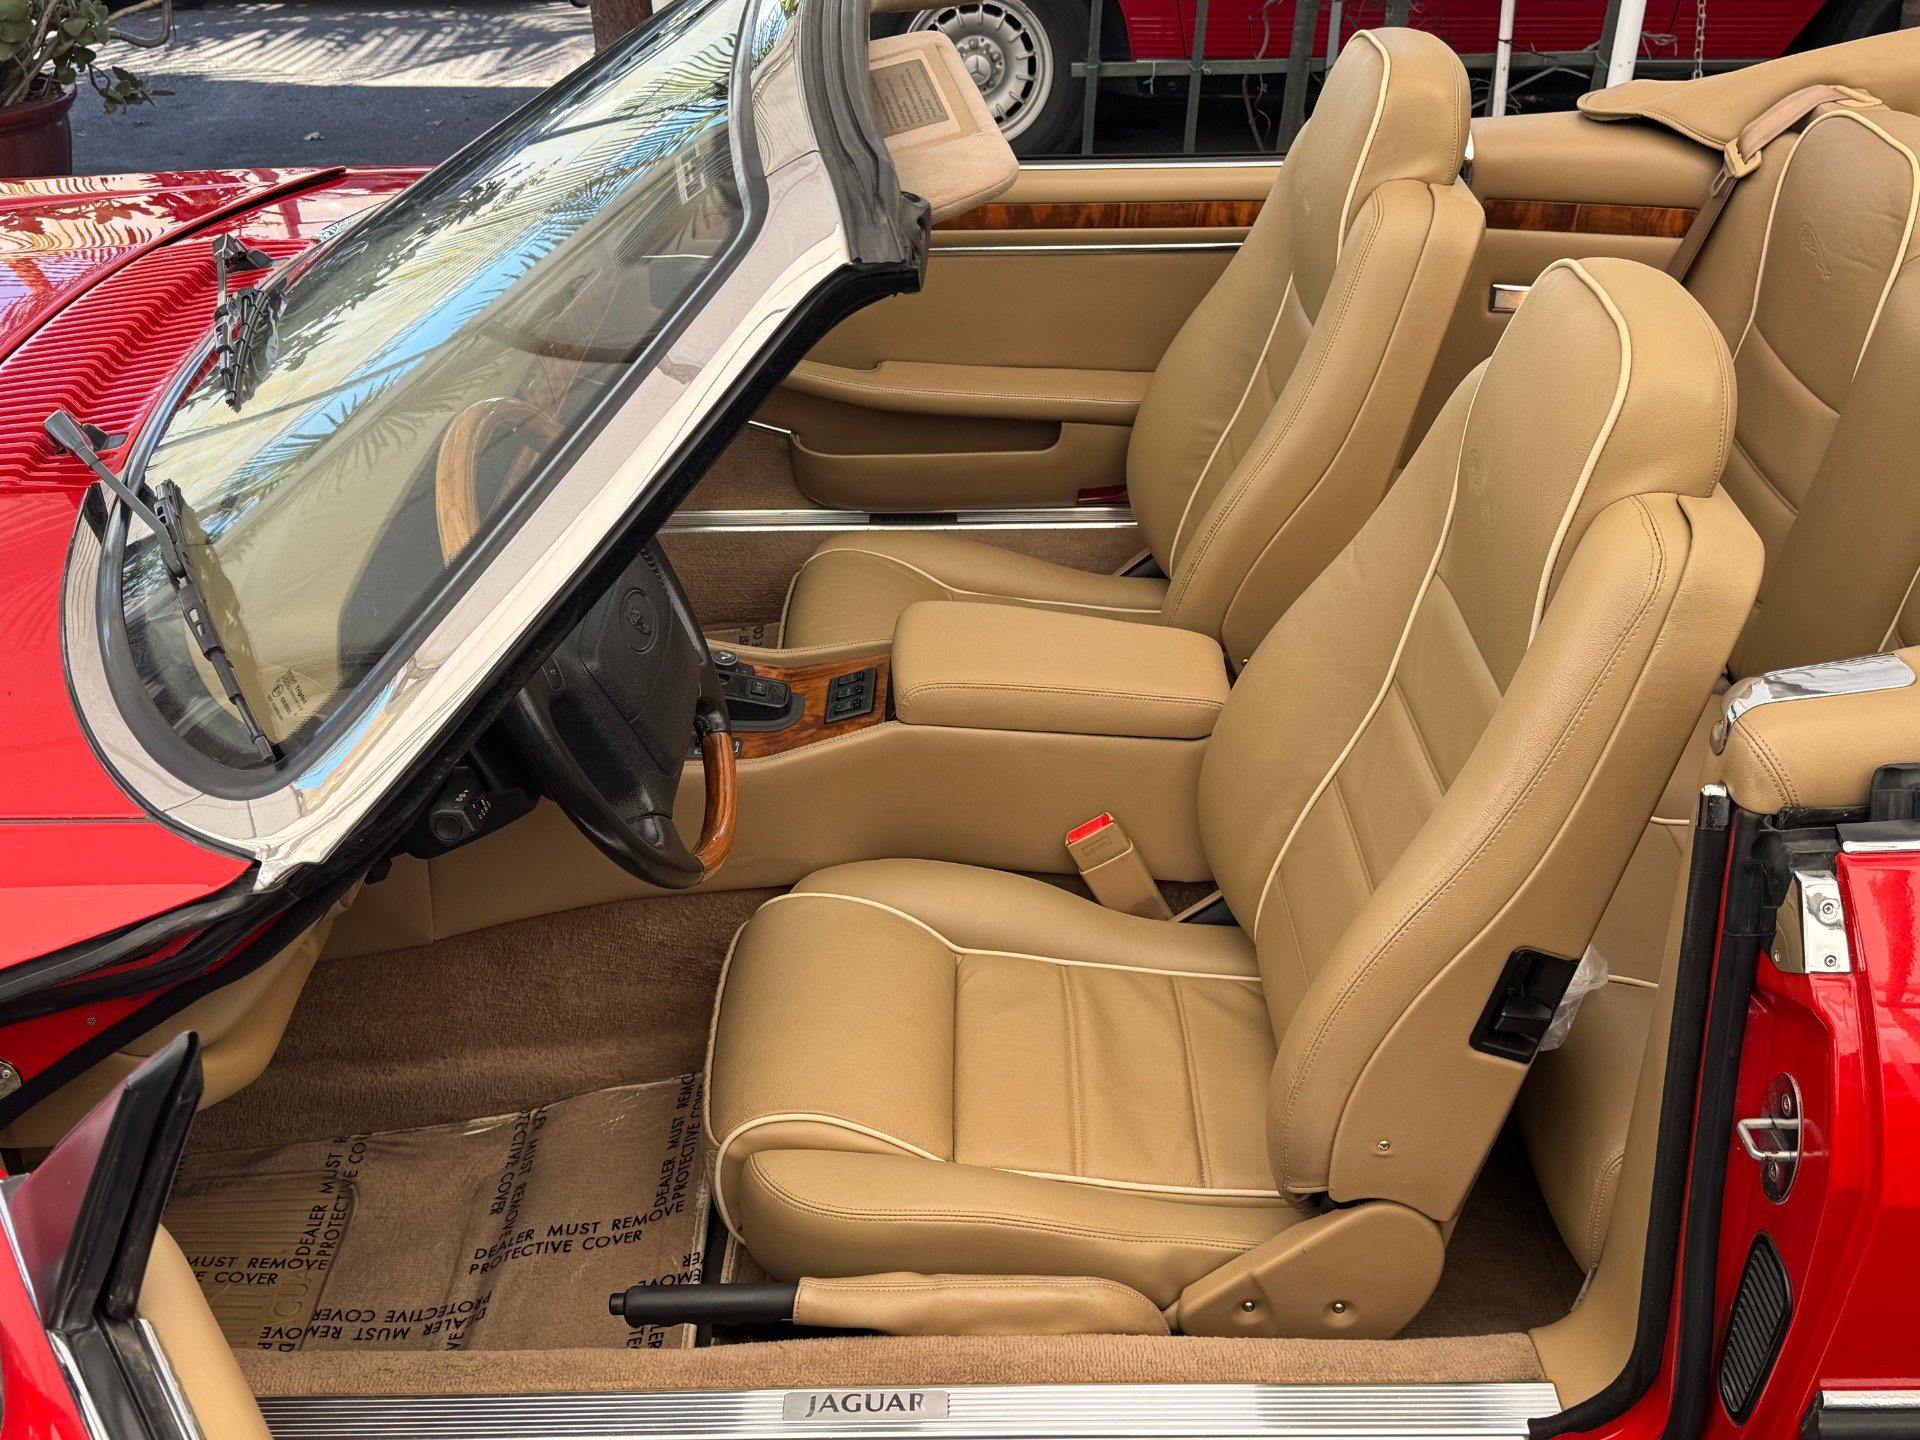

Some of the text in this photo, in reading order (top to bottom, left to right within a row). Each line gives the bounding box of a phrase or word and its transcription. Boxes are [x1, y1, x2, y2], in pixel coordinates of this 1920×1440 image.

[520, 1138, 539, 1176] MUST
[654, 1155, 676, 1207] DEALER
[667, 1116, 685, 1150] MUST
[672, 1122, 700, 1201] PROTECTIVE
[294, 1204, 328, 1256] DEALER
[318, 1152, 343, 1194] MUST
[316, 1170, 358, 1256] PROTECTIVE
[489, 1172, 514, 1216] COVER
[499, 1182, 527, 1241] REMOVE
[468, 1229, 643, 1276] PROTECTIVE COVER
[474, 1200, 685, 1260] DEALER MUST REMOVE
[187, 1256, 330, 1271] MUST REMOVE
[214, 1271, 279, 1285] COVER
[259, 1306, 487, 1341] DEALER MUST REMOVE
[312, 1290, 492, 1323] PROTECTIVE COVER
[804, 1393, 925, 1418] JAGUAR
